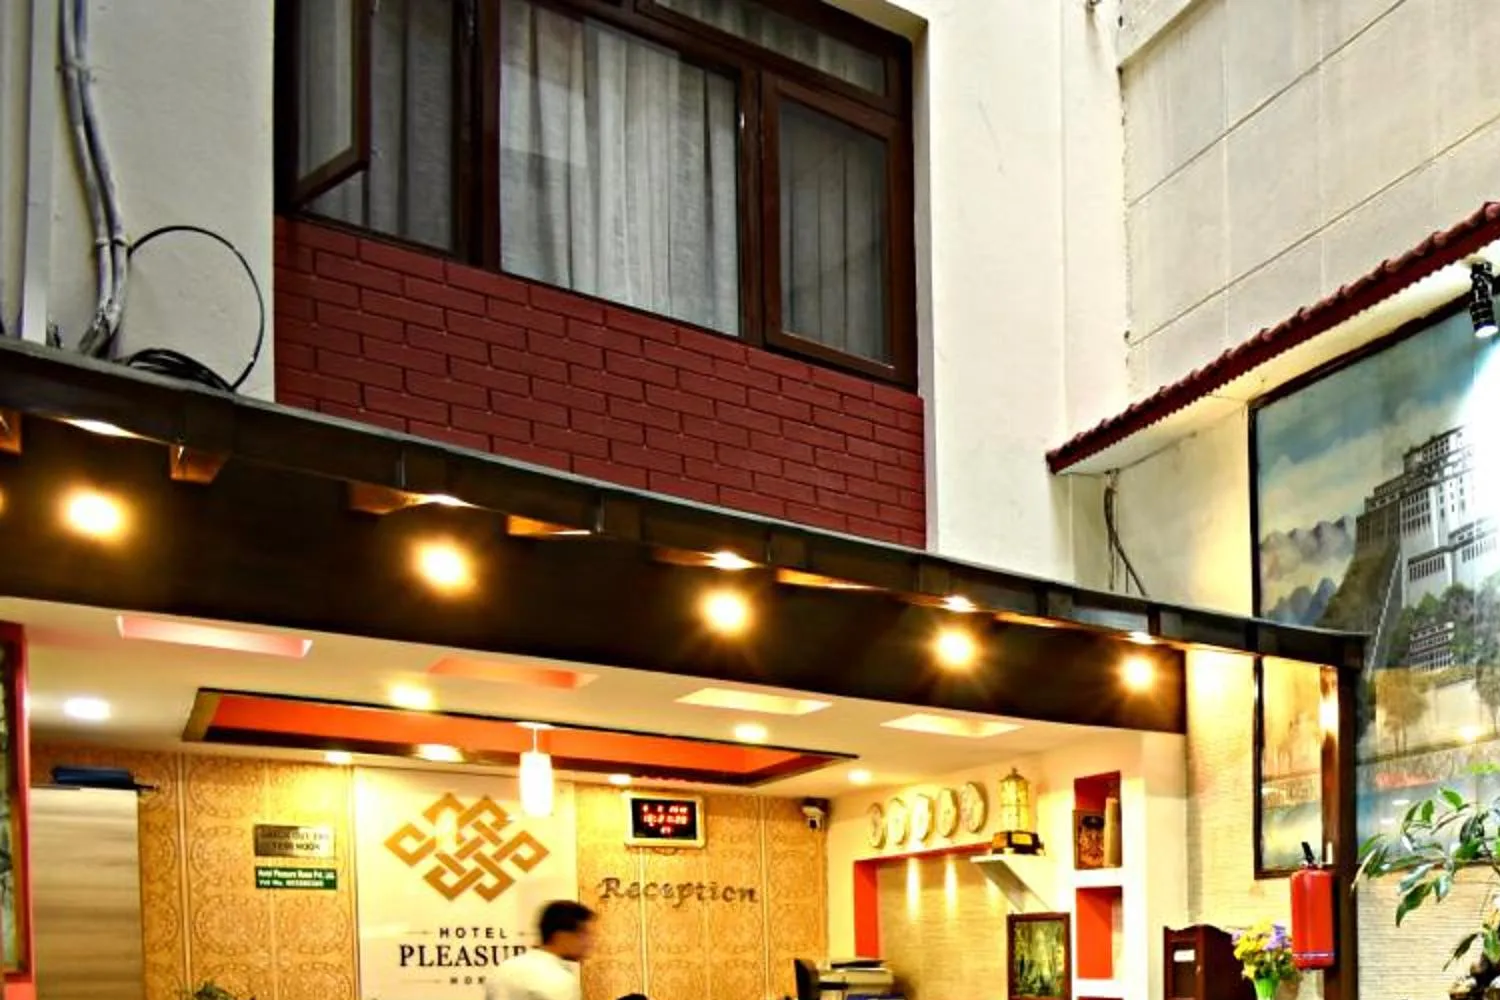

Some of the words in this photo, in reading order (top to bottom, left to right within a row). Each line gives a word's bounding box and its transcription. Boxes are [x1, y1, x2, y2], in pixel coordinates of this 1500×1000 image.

[596, 877, 759, 909] Reception
[439, 927, 508, 939] HOTEL
[399, 944, 541, 967] PLEASUR
